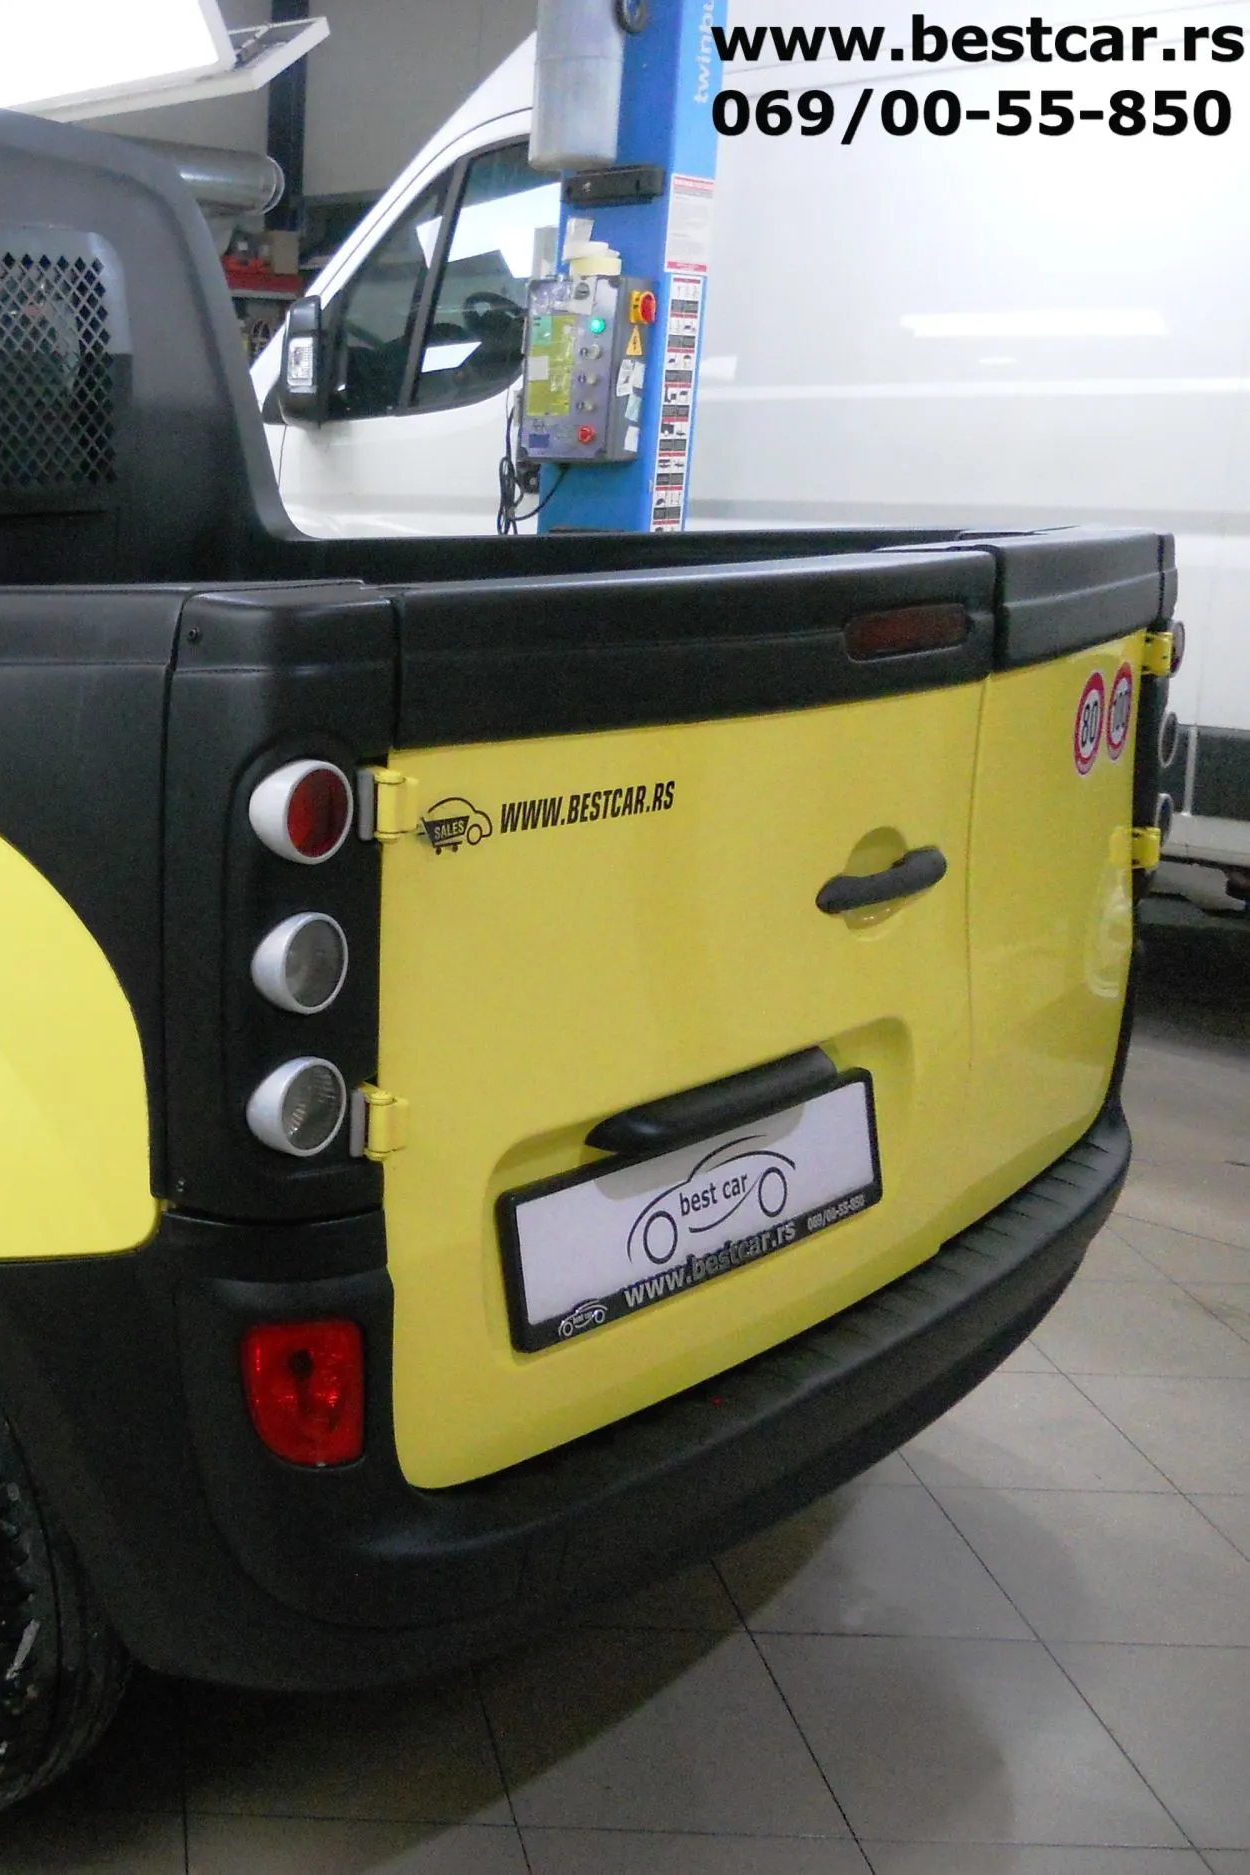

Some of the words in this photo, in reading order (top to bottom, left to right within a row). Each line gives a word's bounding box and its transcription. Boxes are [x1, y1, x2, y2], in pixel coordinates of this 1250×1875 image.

[1081, 699, 1099, 748] 80
[433, 819, 466, 842] SALES
[500, 780, 676, 834] WWW.BESTCAR.RS
[678, 1184, 718, 1217] best
[722, 1173, 749, 1200] car
[623, 1219, 797, 1308] www.bestcar.rs
